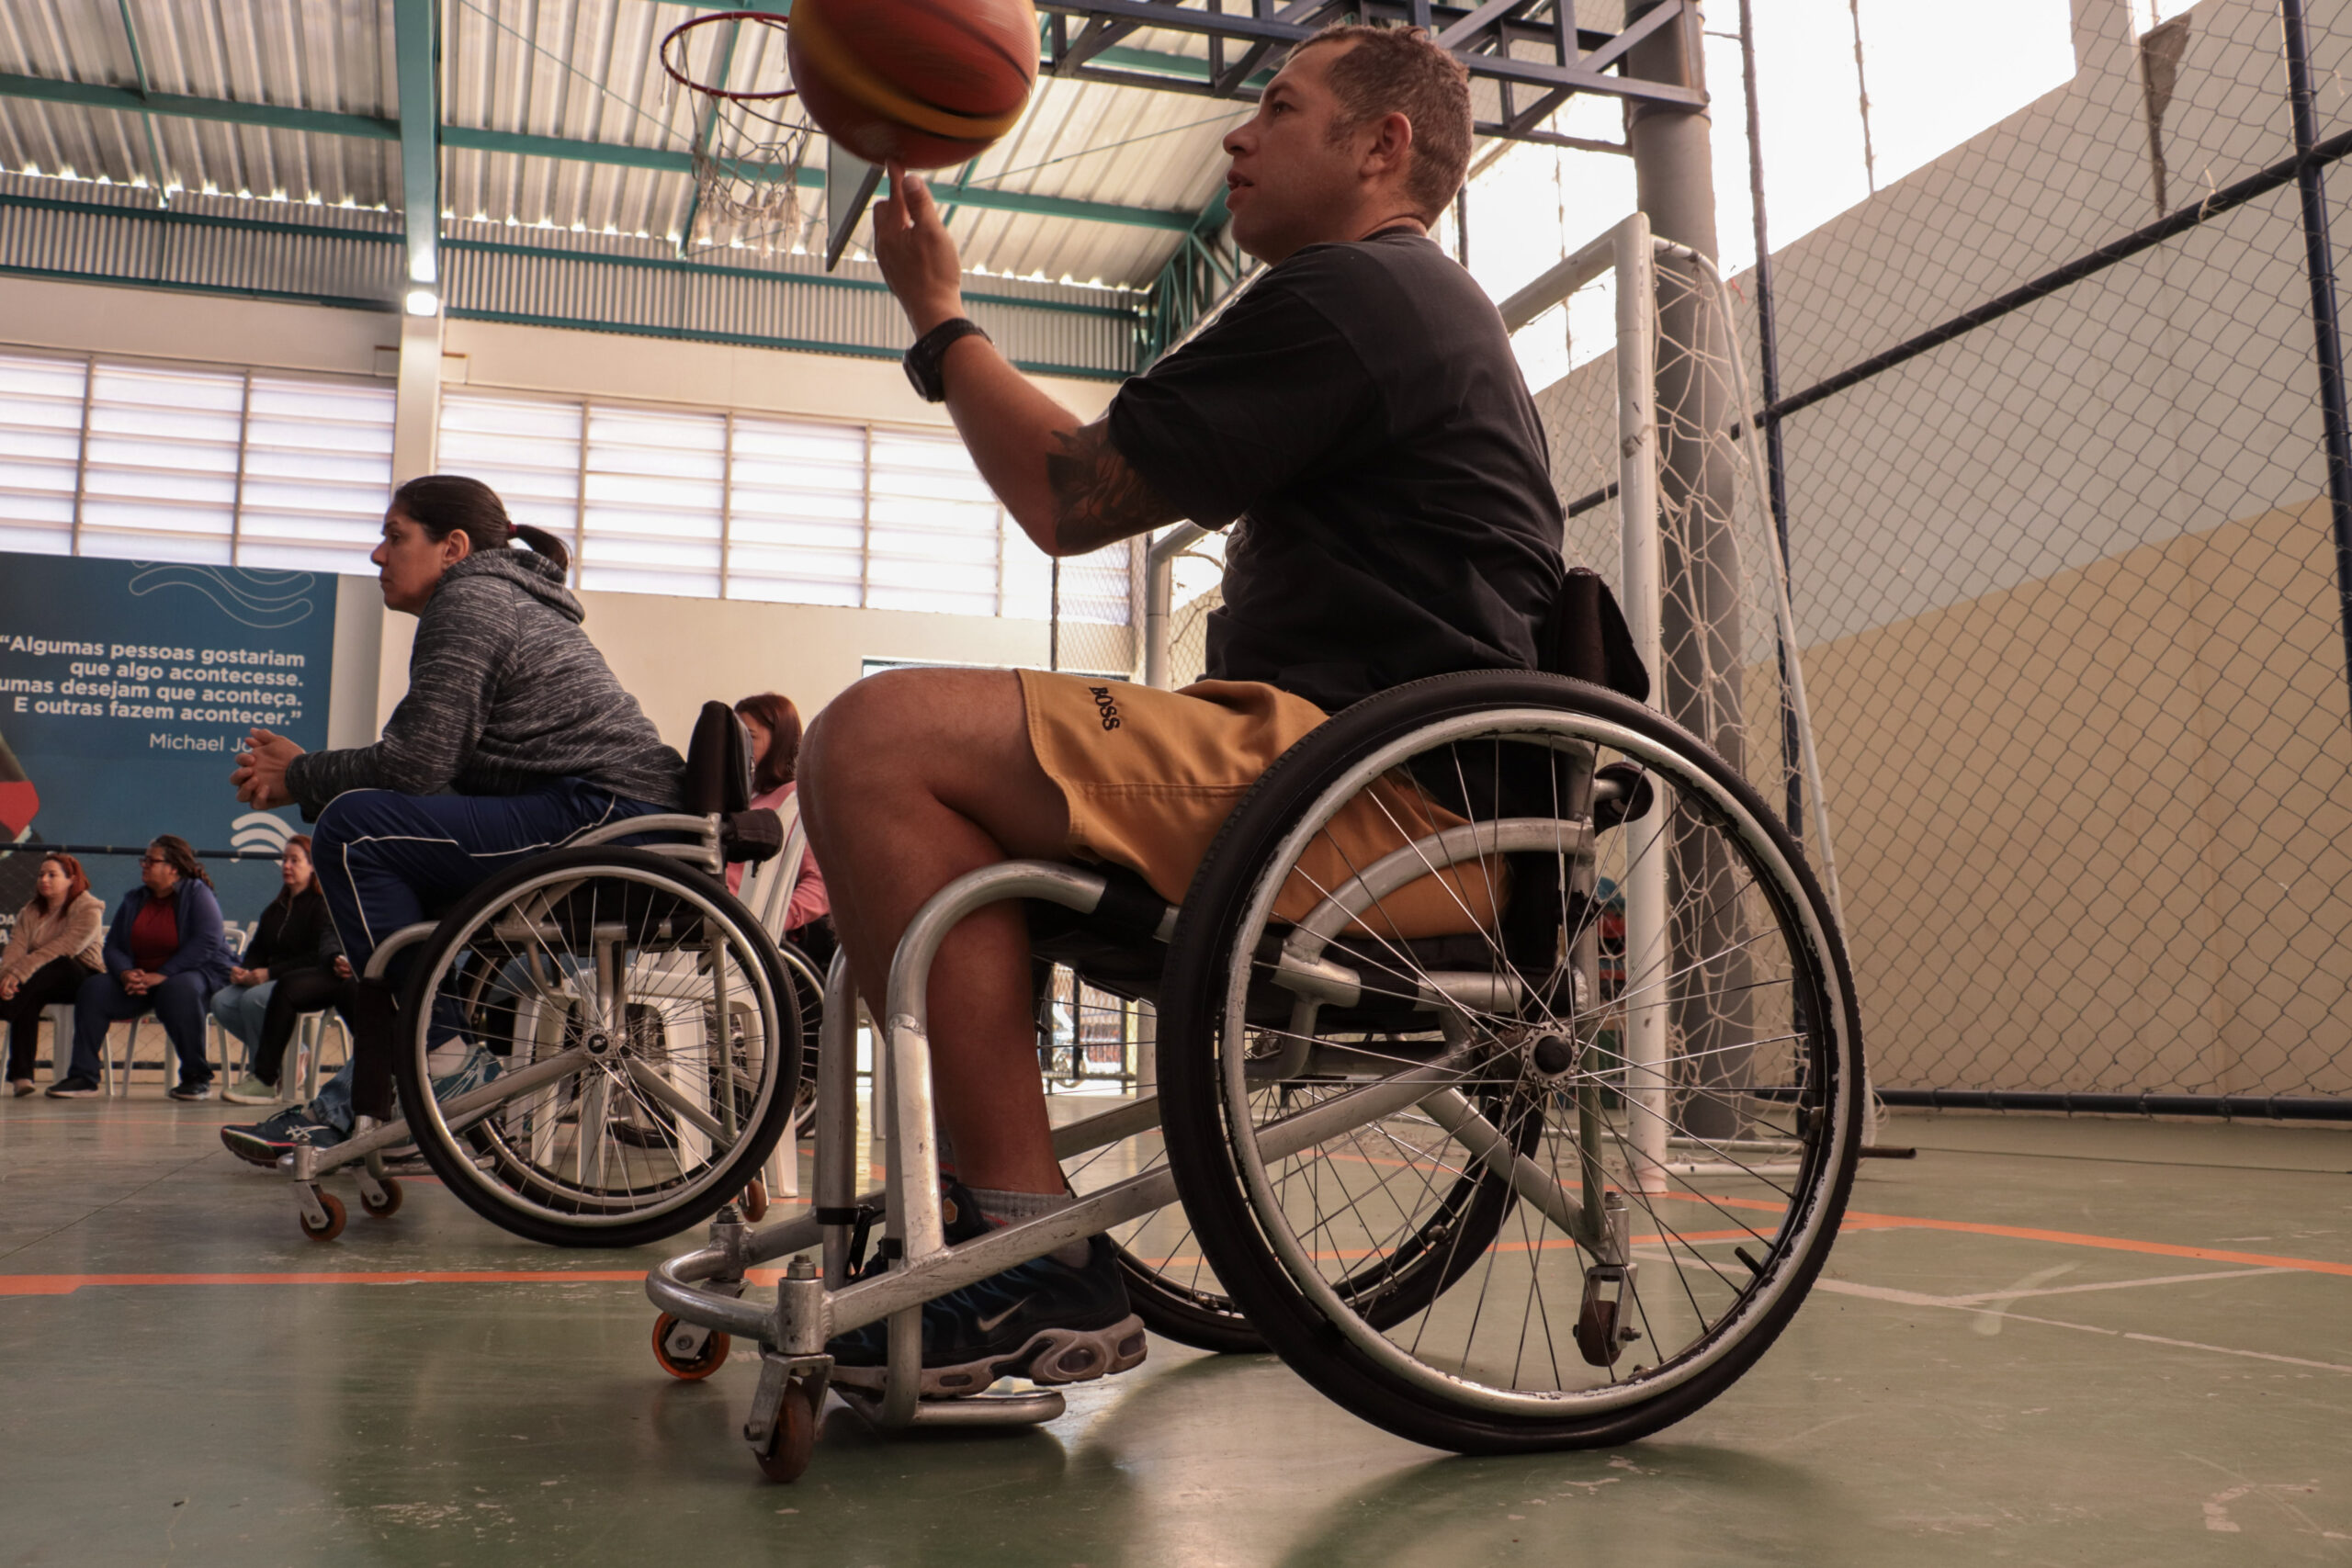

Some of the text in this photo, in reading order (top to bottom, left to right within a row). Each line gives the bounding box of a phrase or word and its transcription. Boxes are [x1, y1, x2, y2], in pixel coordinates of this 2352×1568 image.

[110, 644, 196, 661] pessoas
[200, 649, 305, 668] gostariam
[70, 661, 304, 687] que algo acontecesse.
[60, 678, 151, 700] desejam
[156, 686, 197, 703] que
[201, 689, 302, 708] aconteça.
[14, 696, 302, 726] E outras fazem acontecer.”
[1089, 686, 1120, 730] BOSS
[149, 733, 224, 751] Michael
